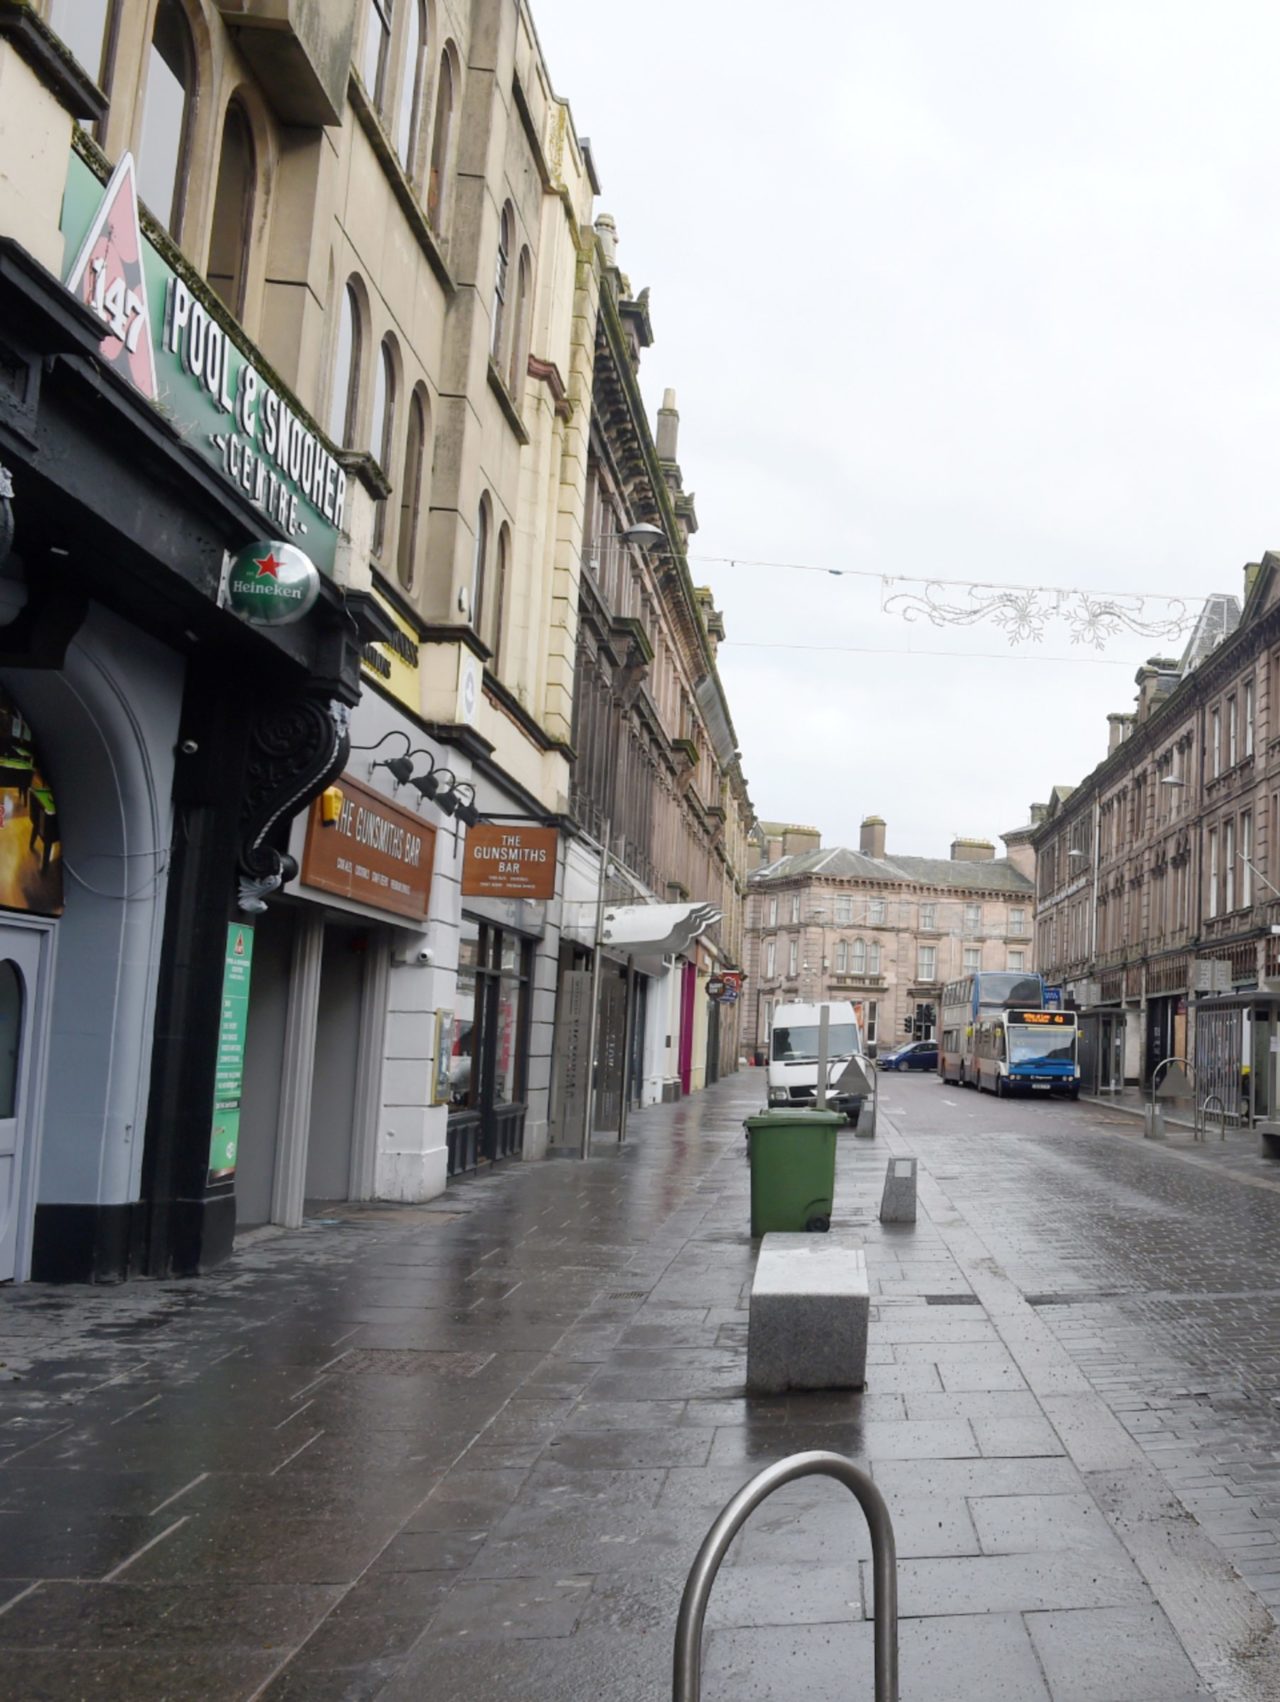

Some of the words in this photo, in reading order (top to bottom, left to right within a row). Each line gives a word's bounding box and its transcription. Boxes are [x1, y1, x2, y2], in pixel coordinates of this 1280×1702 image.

[90, 257, 144, 354] 147
[164, 276, 233, 414] POOL
[238, 364, 257, 437] &
[261, 387, 346, 530] SNOOKER
[233, 580, 302, 599] Heineken
[355, 807, 405, 860] GUNSMITHS
[404, 832, 421, 868] BAR
[501, 835, 521, 847] THE
[473, 846, 546, 863] GUNSMITHS
[498, 862, 520, 874] BAR
